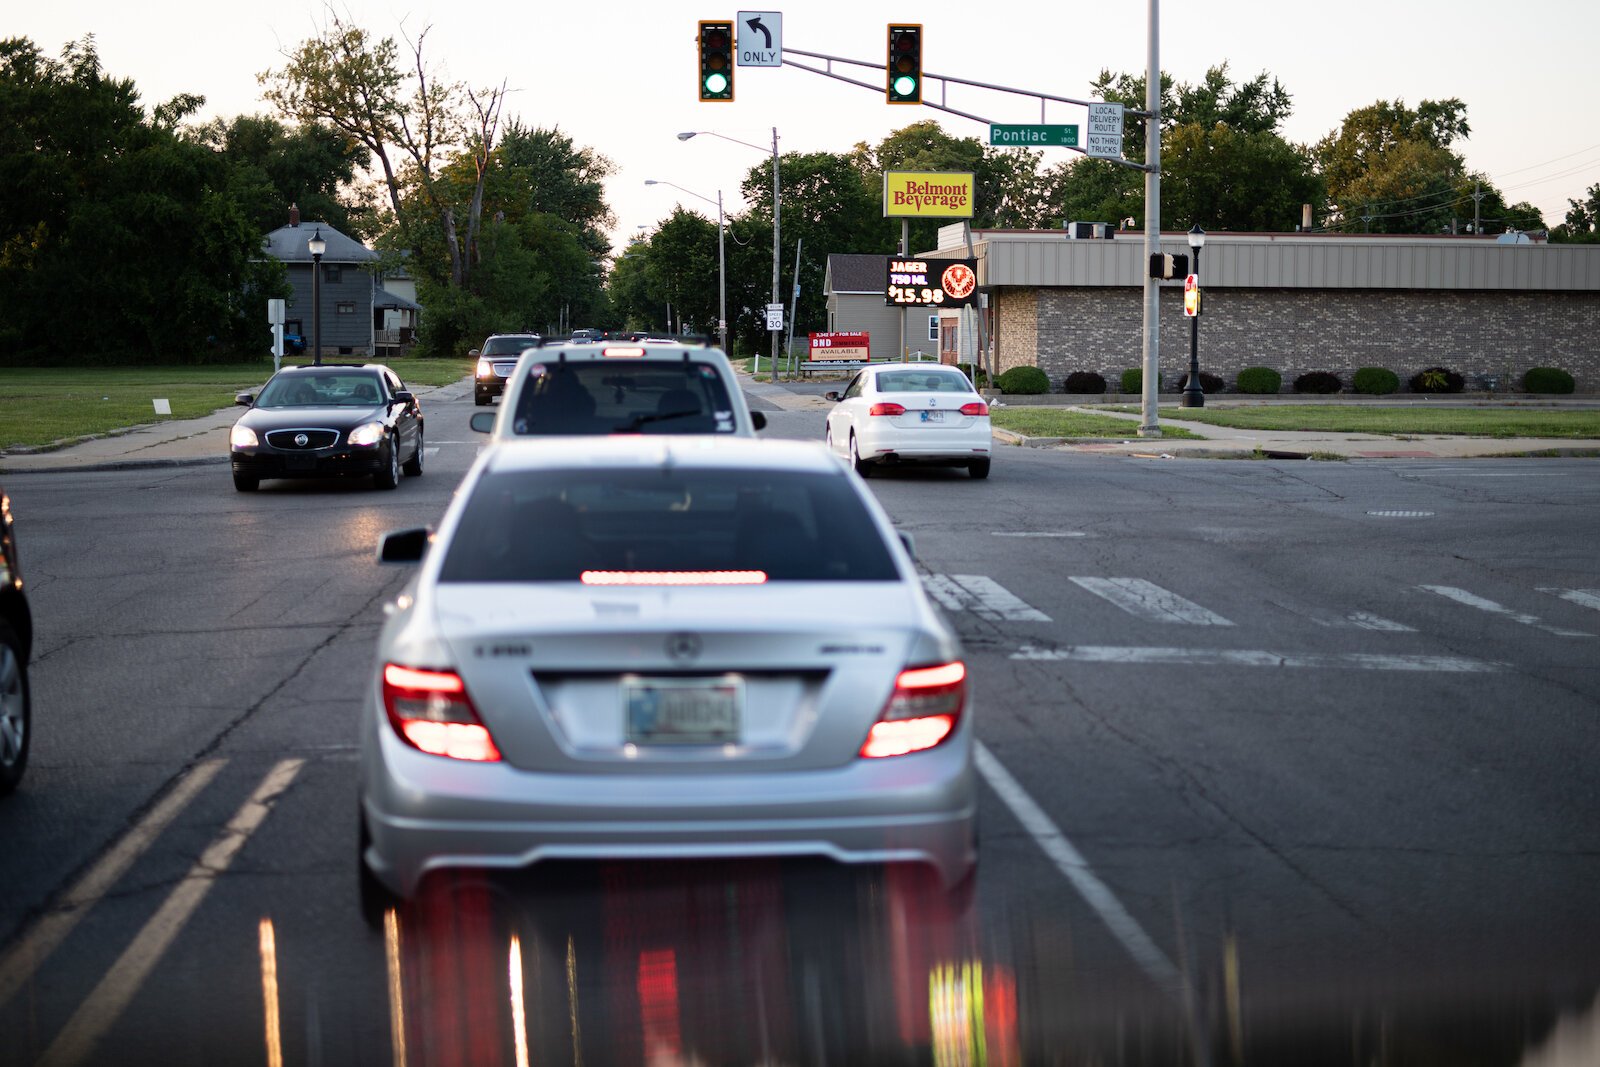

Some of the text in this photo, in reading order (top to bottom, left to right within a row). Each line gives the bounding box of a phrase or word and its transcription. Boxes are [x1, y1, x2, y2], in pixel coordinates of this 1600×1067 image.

[743, 51, 776, 62] ONLY
[1095, 106, 1117, 115] LOCAL
[1090, 115, 1121, 124] DELIVERY
[1094, 124, 1116, 132] ROUTE
[993, 129, 1047, 142] Pontiac
[1089, 137, 1119, 145] NO THRU
[1091, 146, 1118, 154] TRUCKS
[905, 181, 968, 195] Belmont
[893, 191, 967, 212] Beverage
[890, 262, 927, 272] JAGER
[890, 274, 911, 285] 750
[888, 285, 944, 304] $15.98
[813, 339, 831, 347] BND
